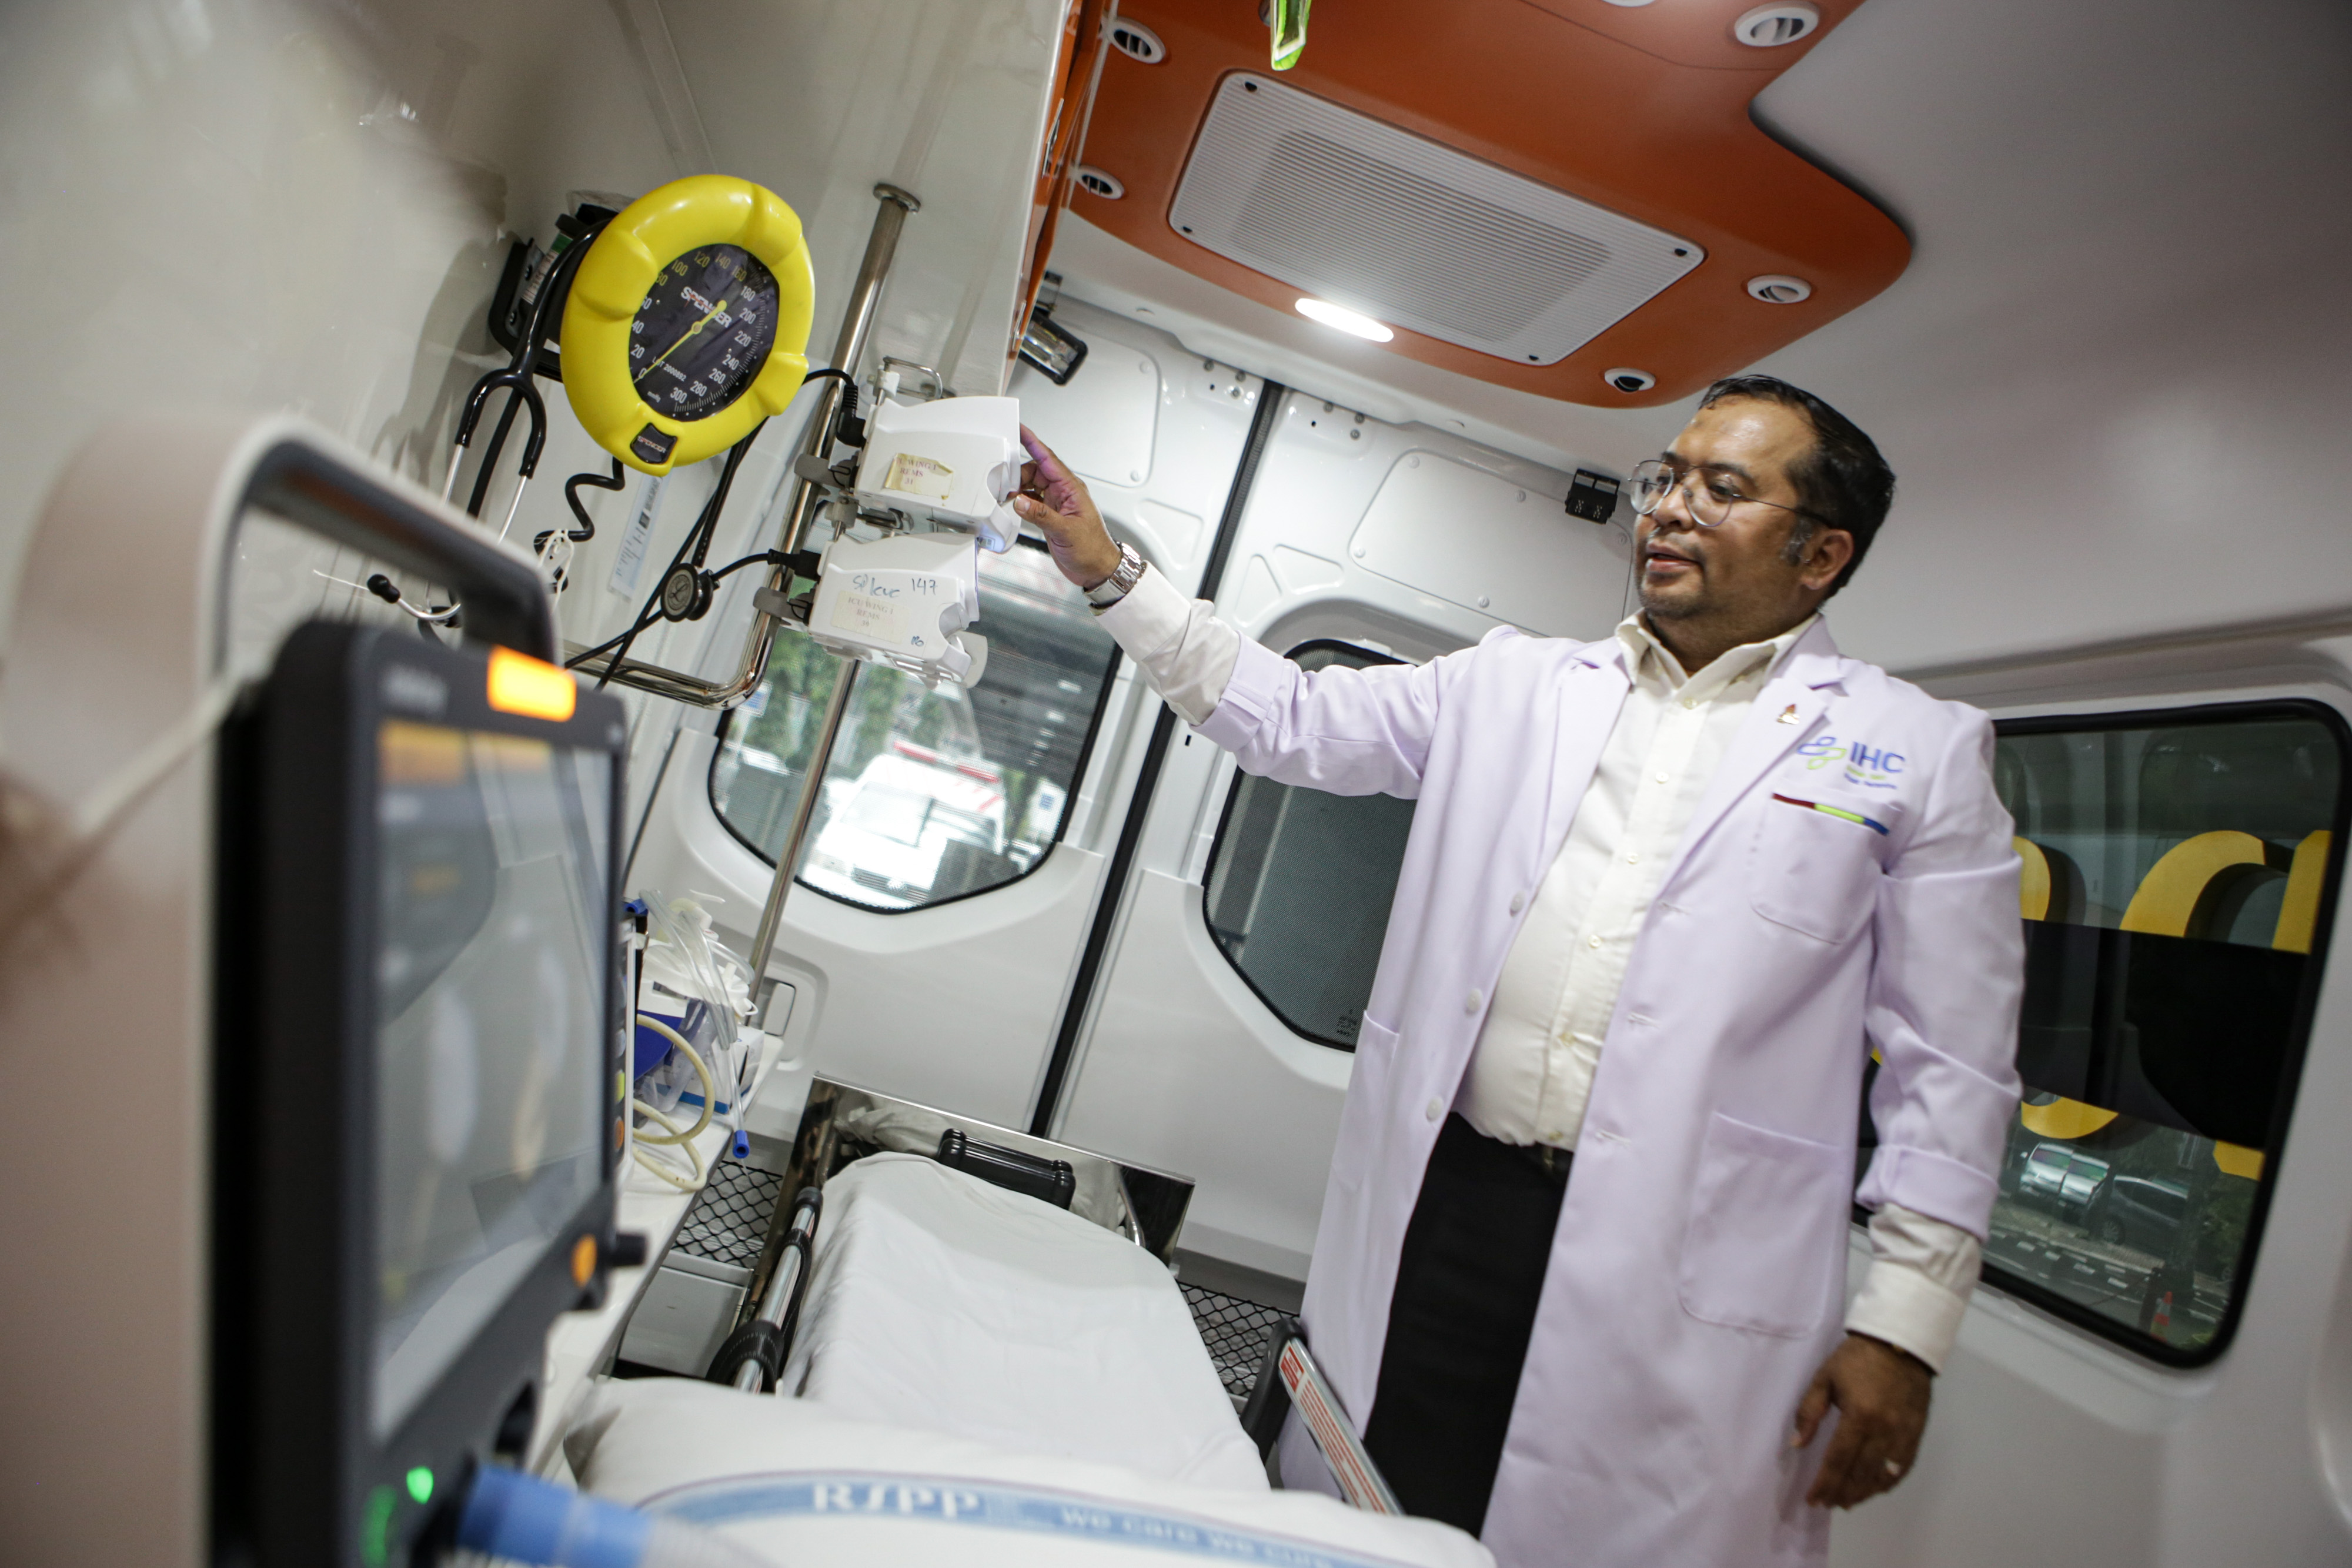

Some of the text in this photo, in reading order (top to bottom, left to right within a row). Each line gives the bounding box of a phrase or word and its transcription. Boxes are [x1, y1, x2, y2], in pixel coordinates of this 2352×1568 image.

[671, 259, 689, 276] 100
[693, 250, 710, 268] 120
[714, 252, 731, 269] 140
[731, 265, 747, 282] 160
[740, 286, 756, 302] 180
[680, 286, 732, 329] SPENER
[739, 307, 756, 325] 200
[632, 320, 644, 334] 40
[734, 330, 751, 347] 220
[630, 344, 645, 359] 20
[722, 354, 740, 370] 240
[709, 368, 726, 385] 260
[670, 387, 687, 404] 300
[690, 381, 707, 397] 280
[1849, 741, 1906, 774] IHC
